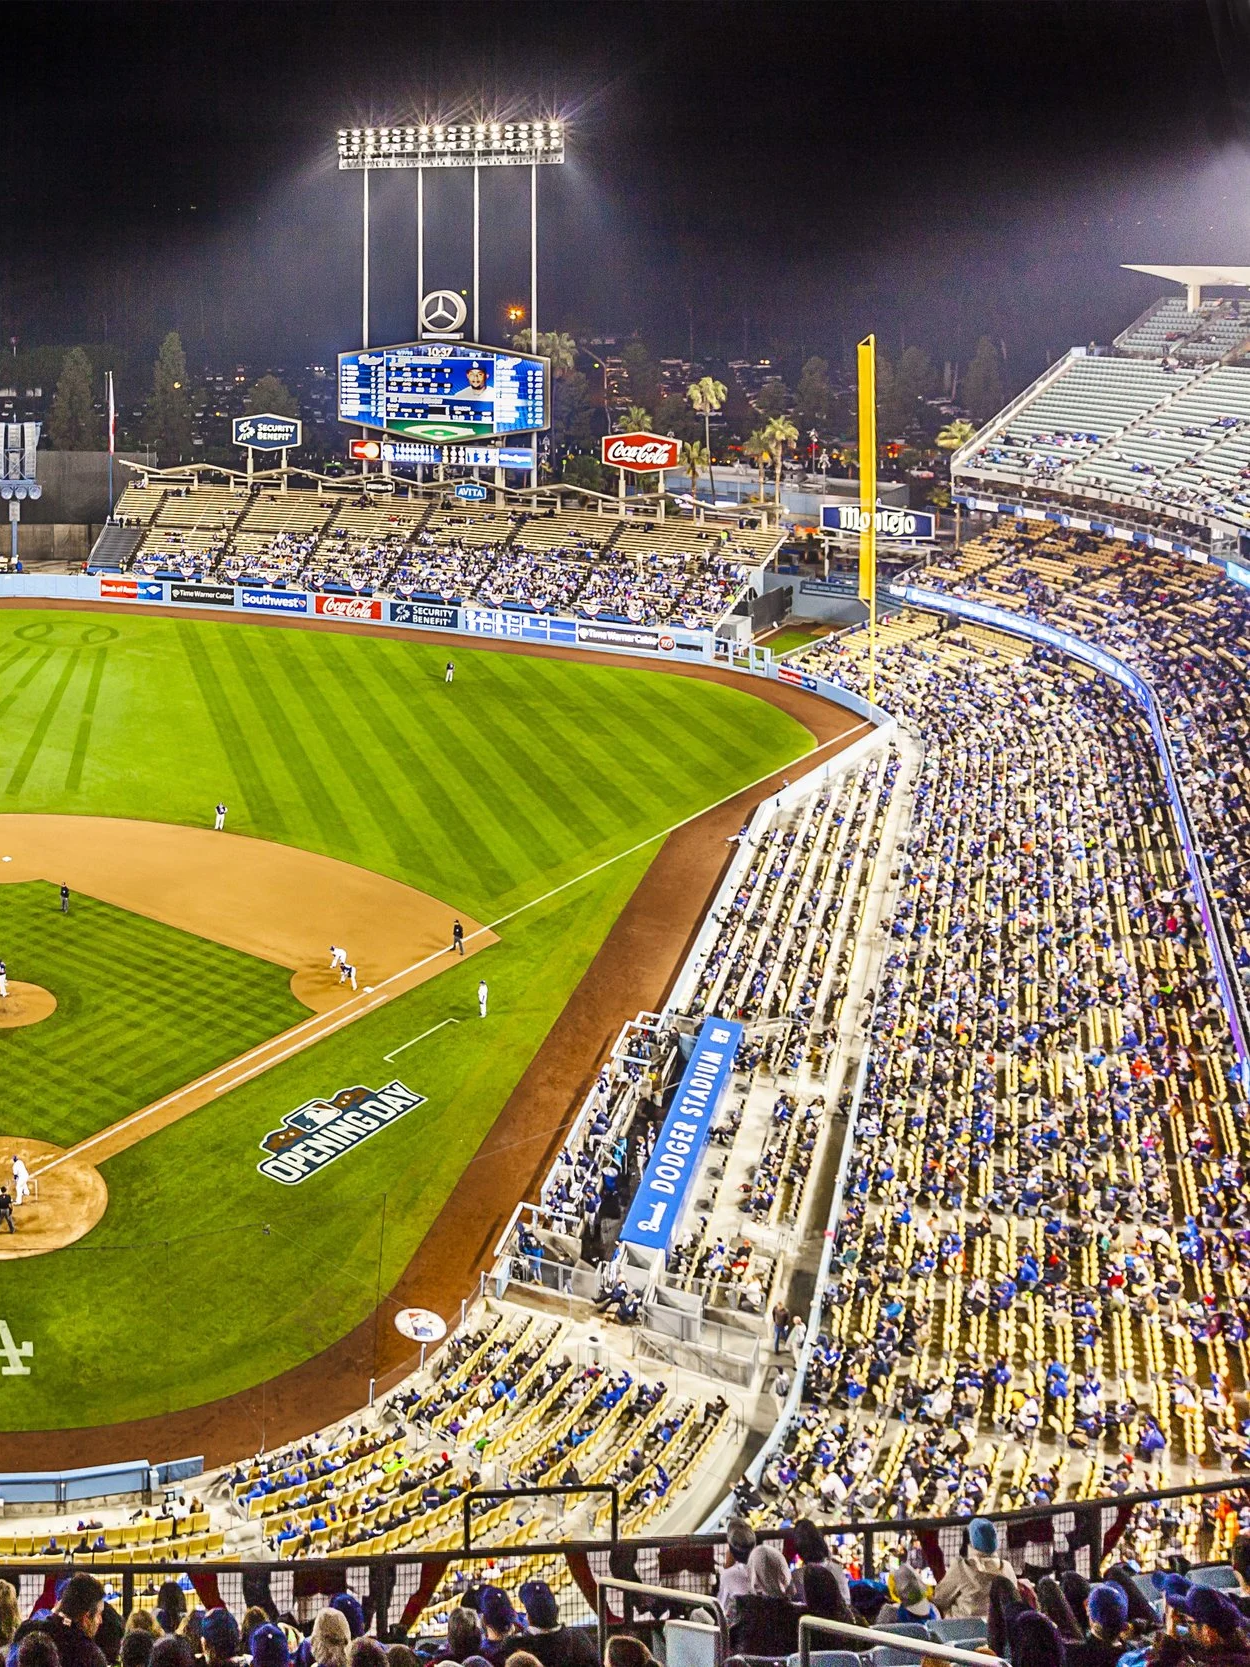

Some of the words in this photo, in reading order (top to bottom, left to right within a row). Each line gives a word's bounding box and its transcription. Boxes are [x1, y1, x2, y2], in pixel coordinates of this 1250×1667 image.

[257, 423, 295, 433] SECURITY
[257, 432, 290, 441] BENEFIT
[457, 488, 484, 498] AVITA
[838, 506, 917, 536] Montejo
[215, 591, 233, 600] Cable
[243, 593, 298, 608] Southwest
[412, 606, 454, 617] SECURITY
[412, 615, 448, 626] BENEFIT
[650, 1120, 698, 1195] DODGER
[679, 1050, 724, 1118] STADIUM
[261, 1110, 381, 1183] OPENING
[358, 1082, 421, 1121] DAY
